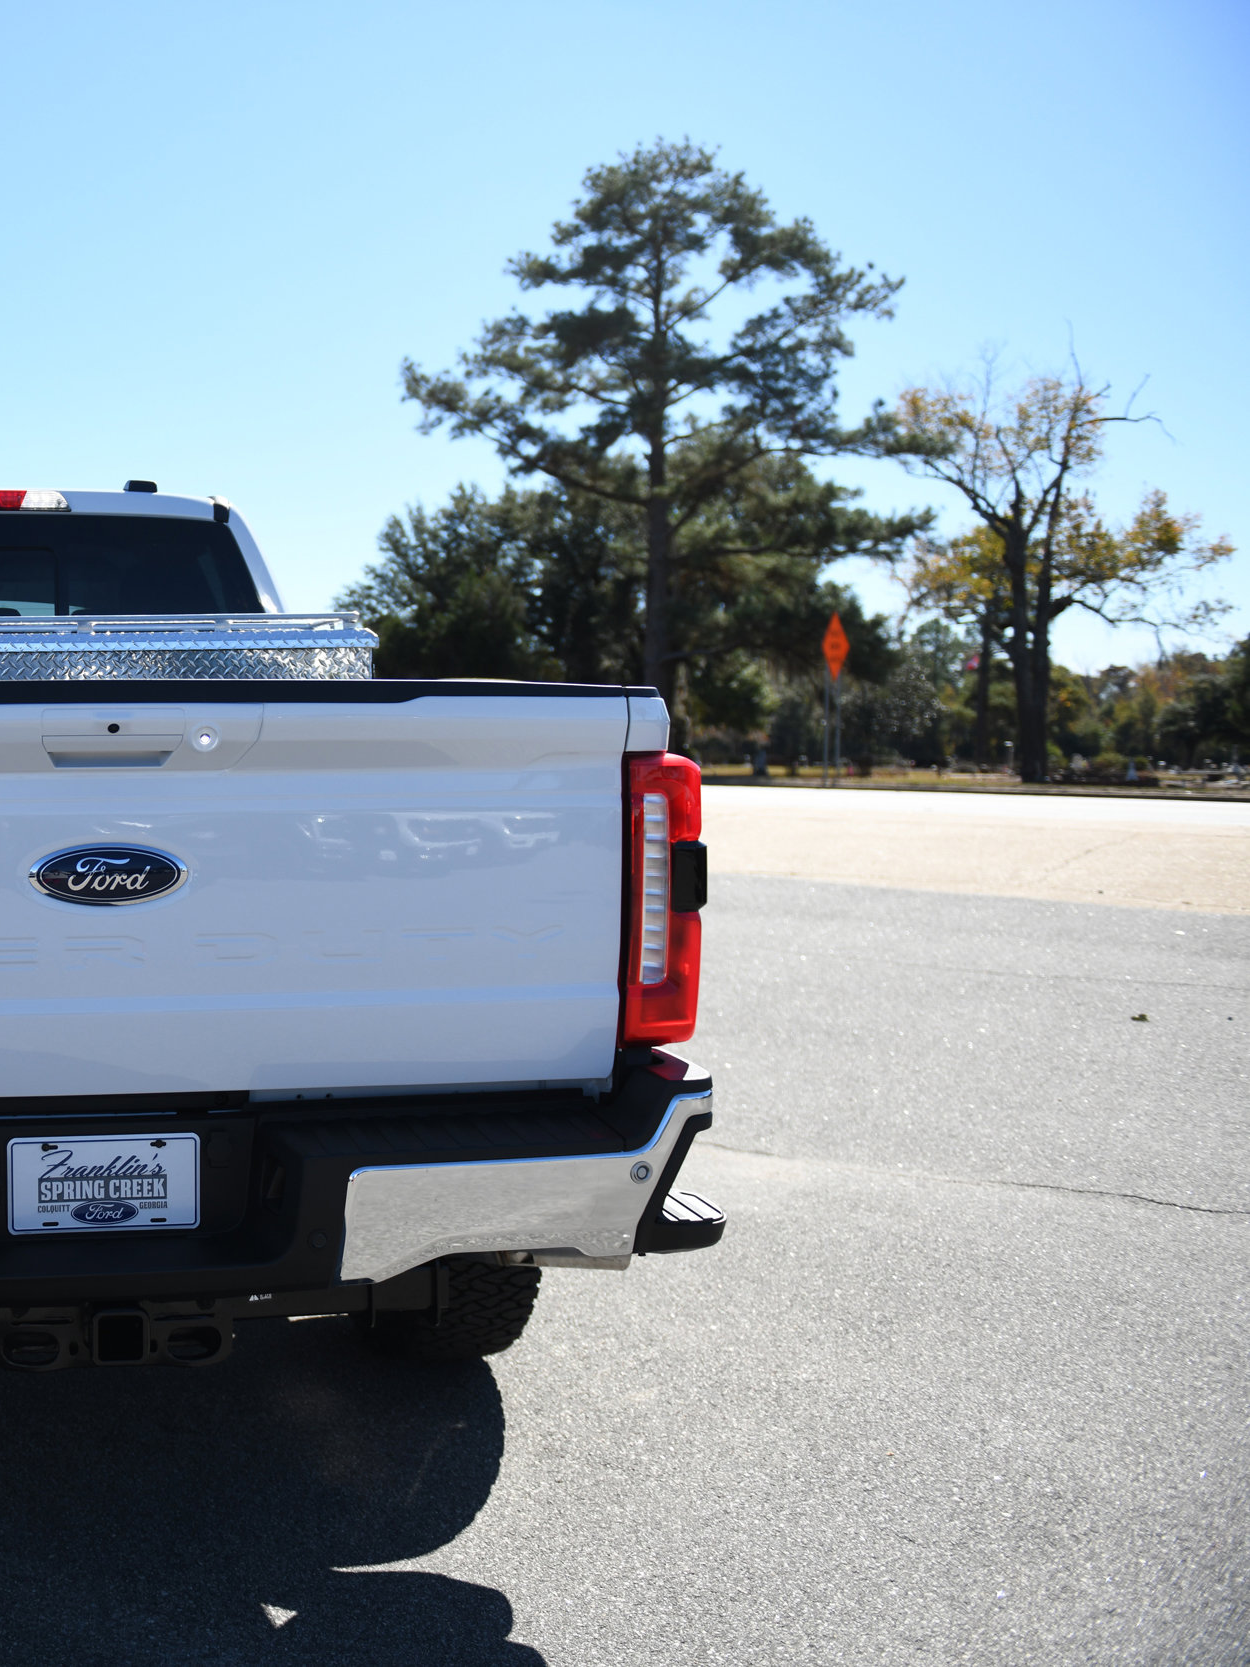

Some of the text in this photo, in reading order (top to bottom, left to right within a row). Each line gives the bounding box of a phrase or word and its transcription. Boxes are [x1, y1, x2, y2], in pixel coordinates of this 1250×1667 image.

[67, 857, 150, 891] Ford
[40, 1149, 166, 1179] Franklin's
[40, 1177, 165, 1201] SPRING CREEK
[37, 1203, 70, 1213] COLQUITT
[85, 1203, 124, 1220] Ford
[139, 1201, 168, 1210] GEORGIA
